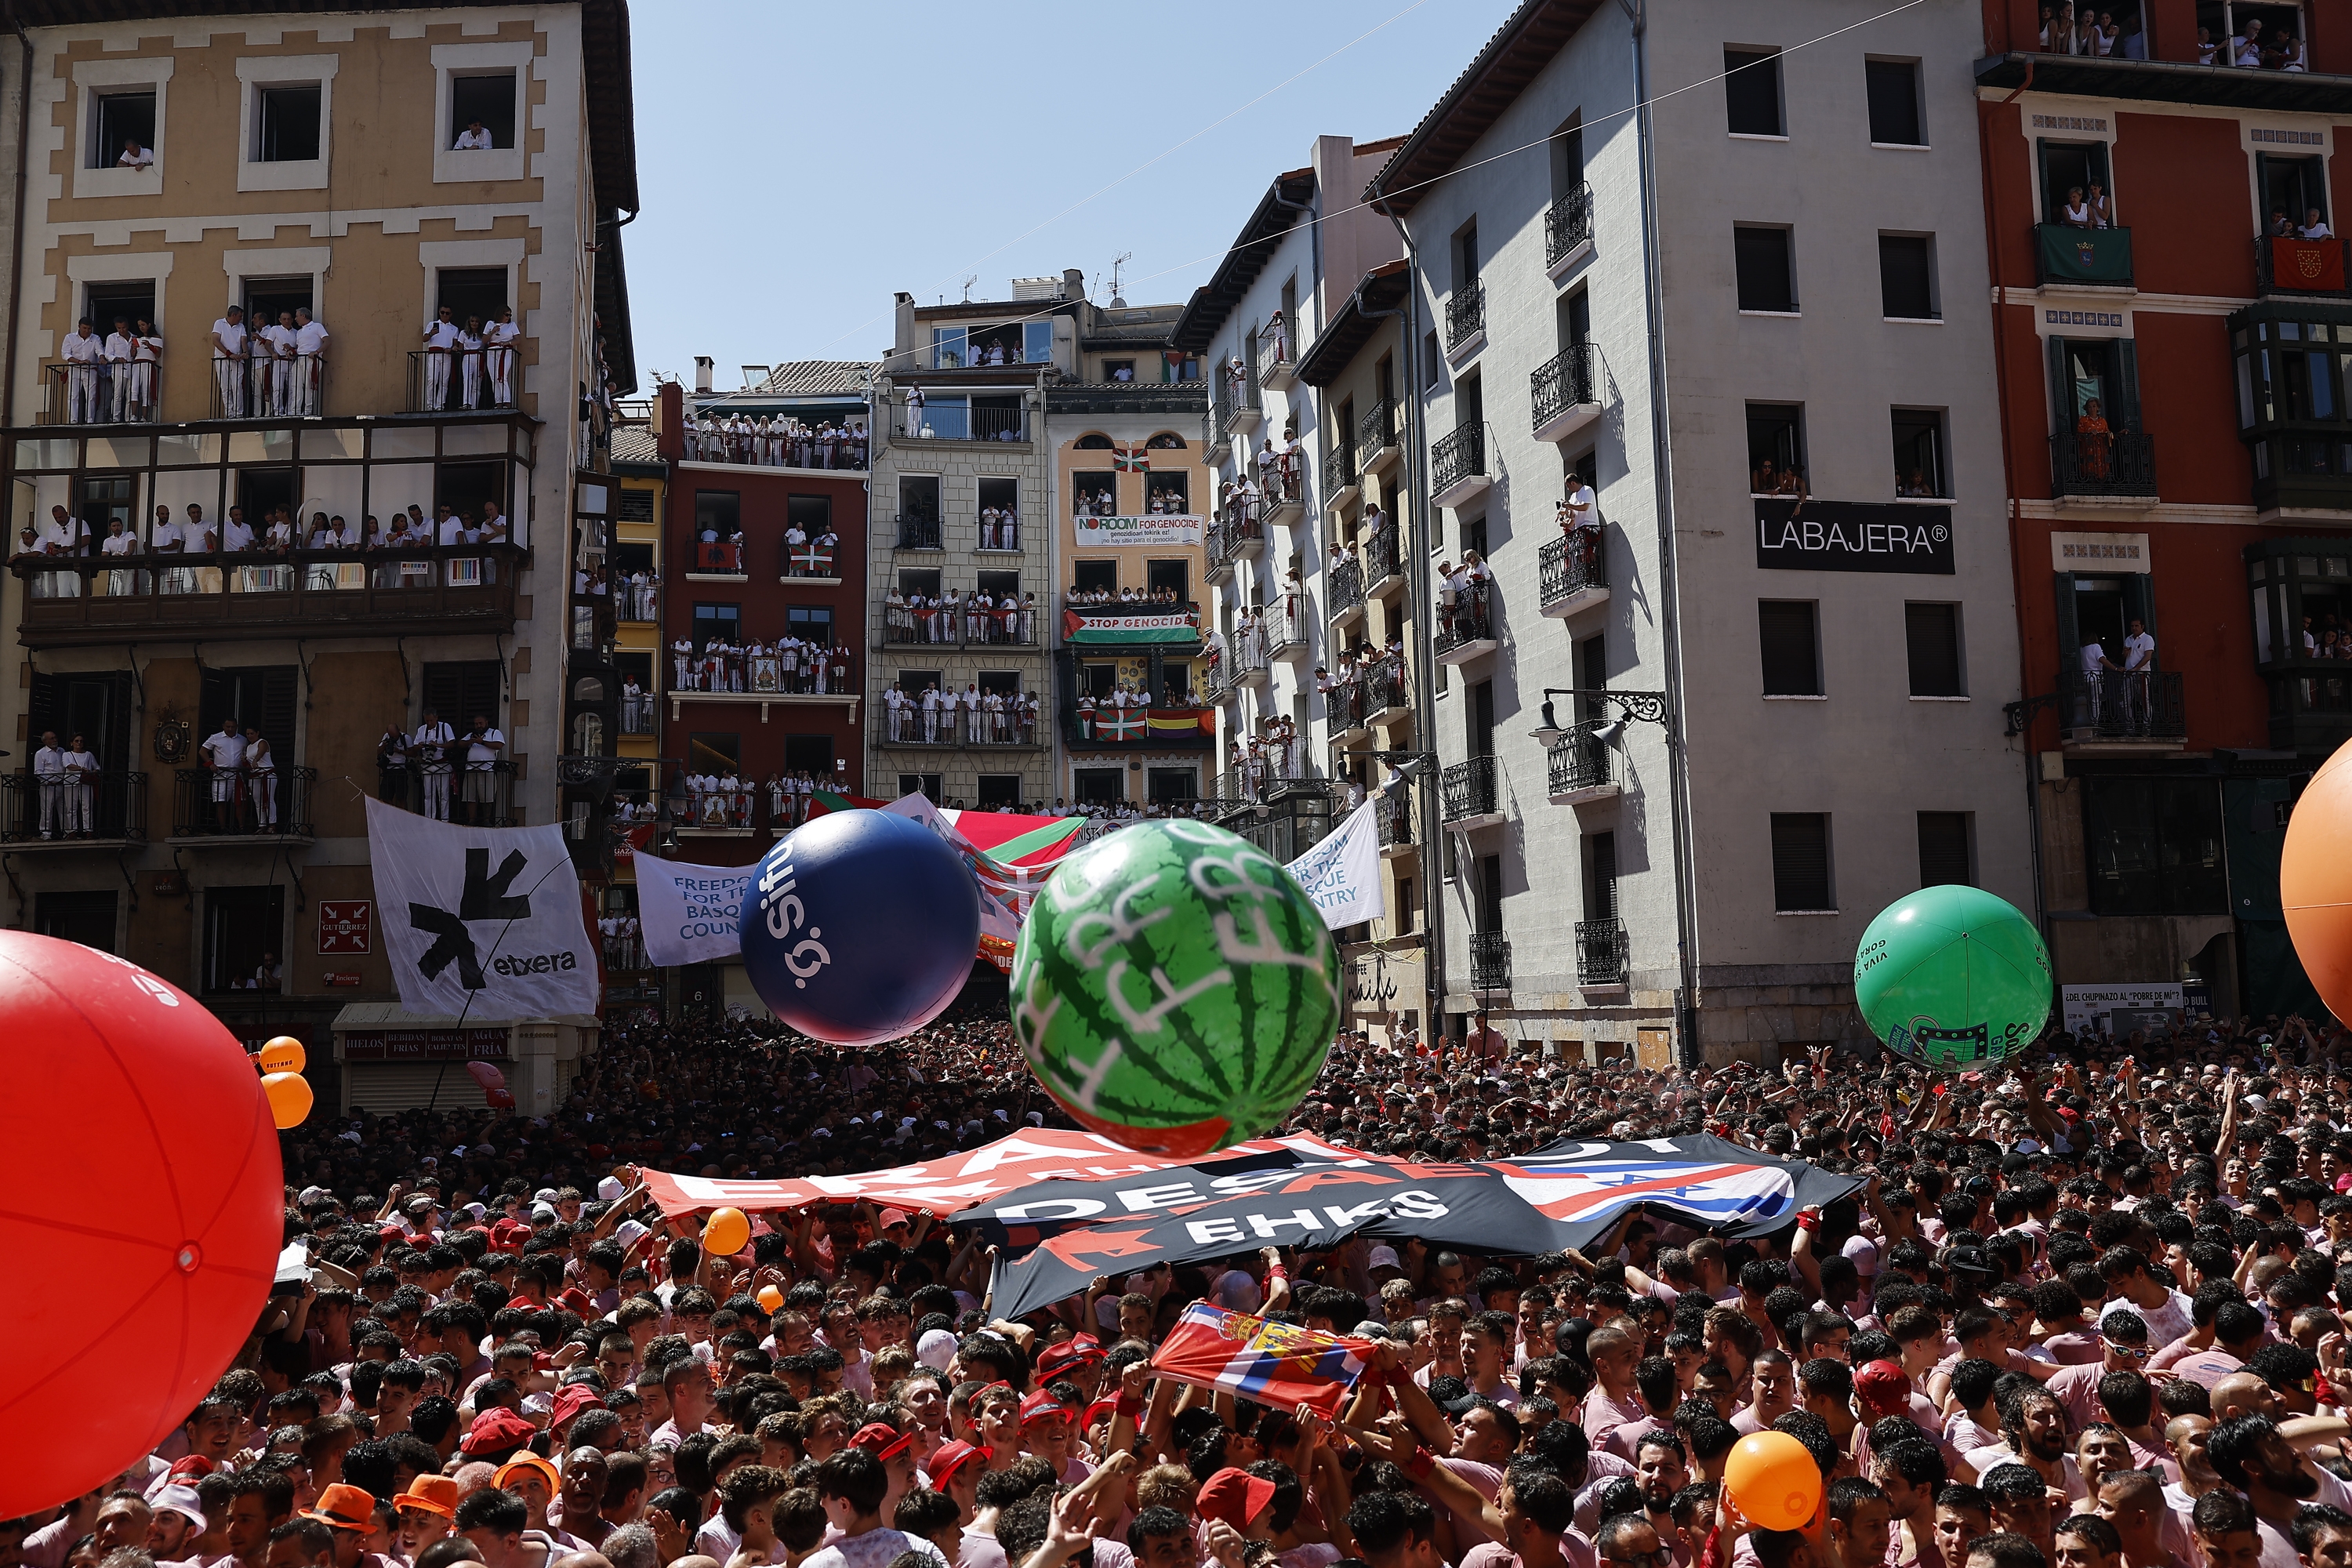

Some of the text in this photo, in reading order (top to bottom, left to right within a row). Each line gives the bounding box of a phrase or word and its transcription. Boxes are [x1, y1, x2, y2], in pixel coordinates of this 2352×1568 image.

[1099, 517, 1137, 530] ROOM
[1139, 521, 1156, 529] FOR
[1157, 519, 1200, 529] GENOCIDE
[1088, 616, 1190, 628] STOP GENOCIDE
[674, 876, 751, 891] FREEDO
[758, 837, 805, 939] sifu
[683, 886, 747, 905] FOR TH
[1311, 886, 1358, 909] NTRY
[686, 902, 742, 920] BASQ
[322, 923, 368, 931] GUTIERREZ
[679, 921, 740, 940] COUN
[1860, 939, 1886, 957] GORA
[493, 951, 577, 977] etxera
[1863, 951, 1889, 971] VIVA
[1348, 963, 1367, 975] COFFEE
[1348, 955, 1398, 1002] nails
[694, 991, 702, 1001] 6
[2066, 993, 2081, 1002] ¿DEL
[2082, 992, 2118, 1002] CHUPINAZO
[2119, 992, 2128, 1001] AL
[2155, 991, 2163, 1000] DE
[2190, 996, 2208, 1006] BULL
[2186, 1007, 2197, 1017] DA
[471, 1029, 505, 1040] AGUA
[347, 1039, 384, 1049] HIELOS
[394, 1042, 419, 1052] FRÍAS
[474, 1044, 503, 1056] FRÍA
[1185, 1189, 1450, 1245] EHKS
